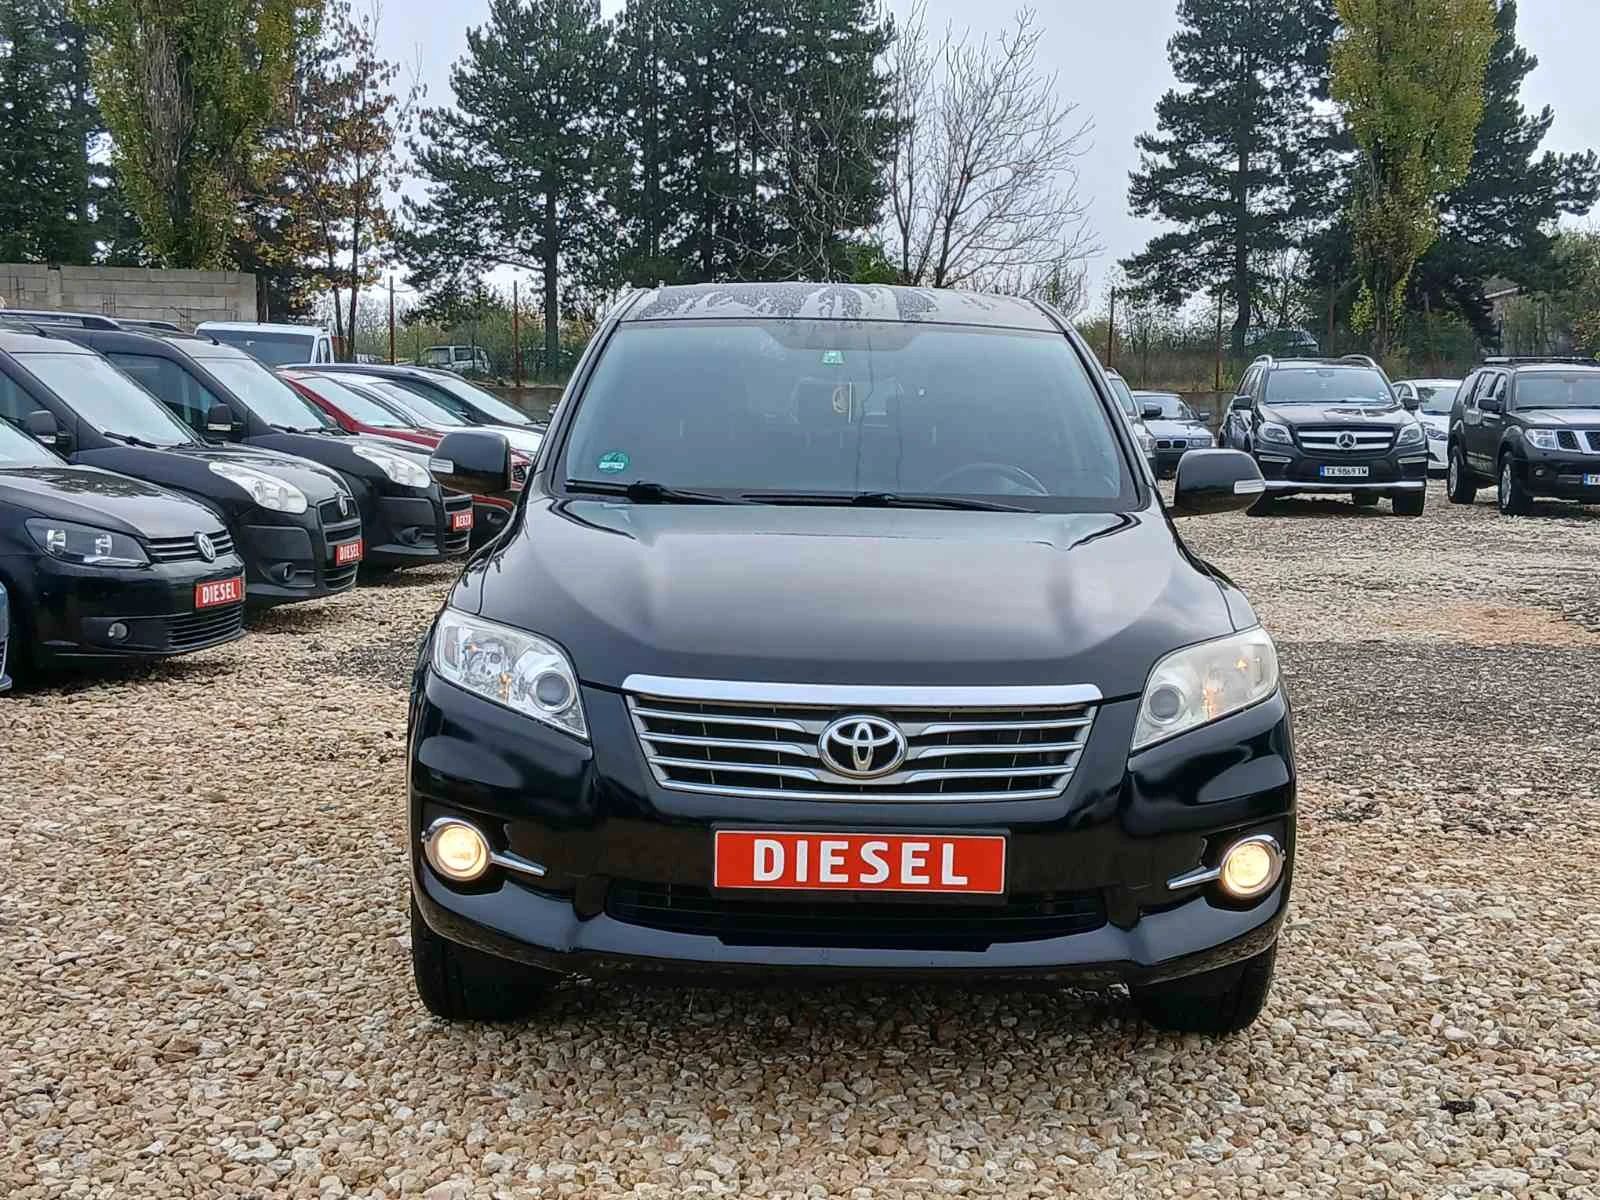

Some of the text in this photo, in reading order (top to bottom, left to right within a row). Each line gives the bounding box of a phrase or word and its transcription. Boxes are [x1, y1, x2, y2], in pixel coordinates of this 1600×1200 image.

[339, 543, 360, 561] DIESEL
[202, 581, 236, 604] DIESEL
[753, 838, 968, 885] DIESEL
